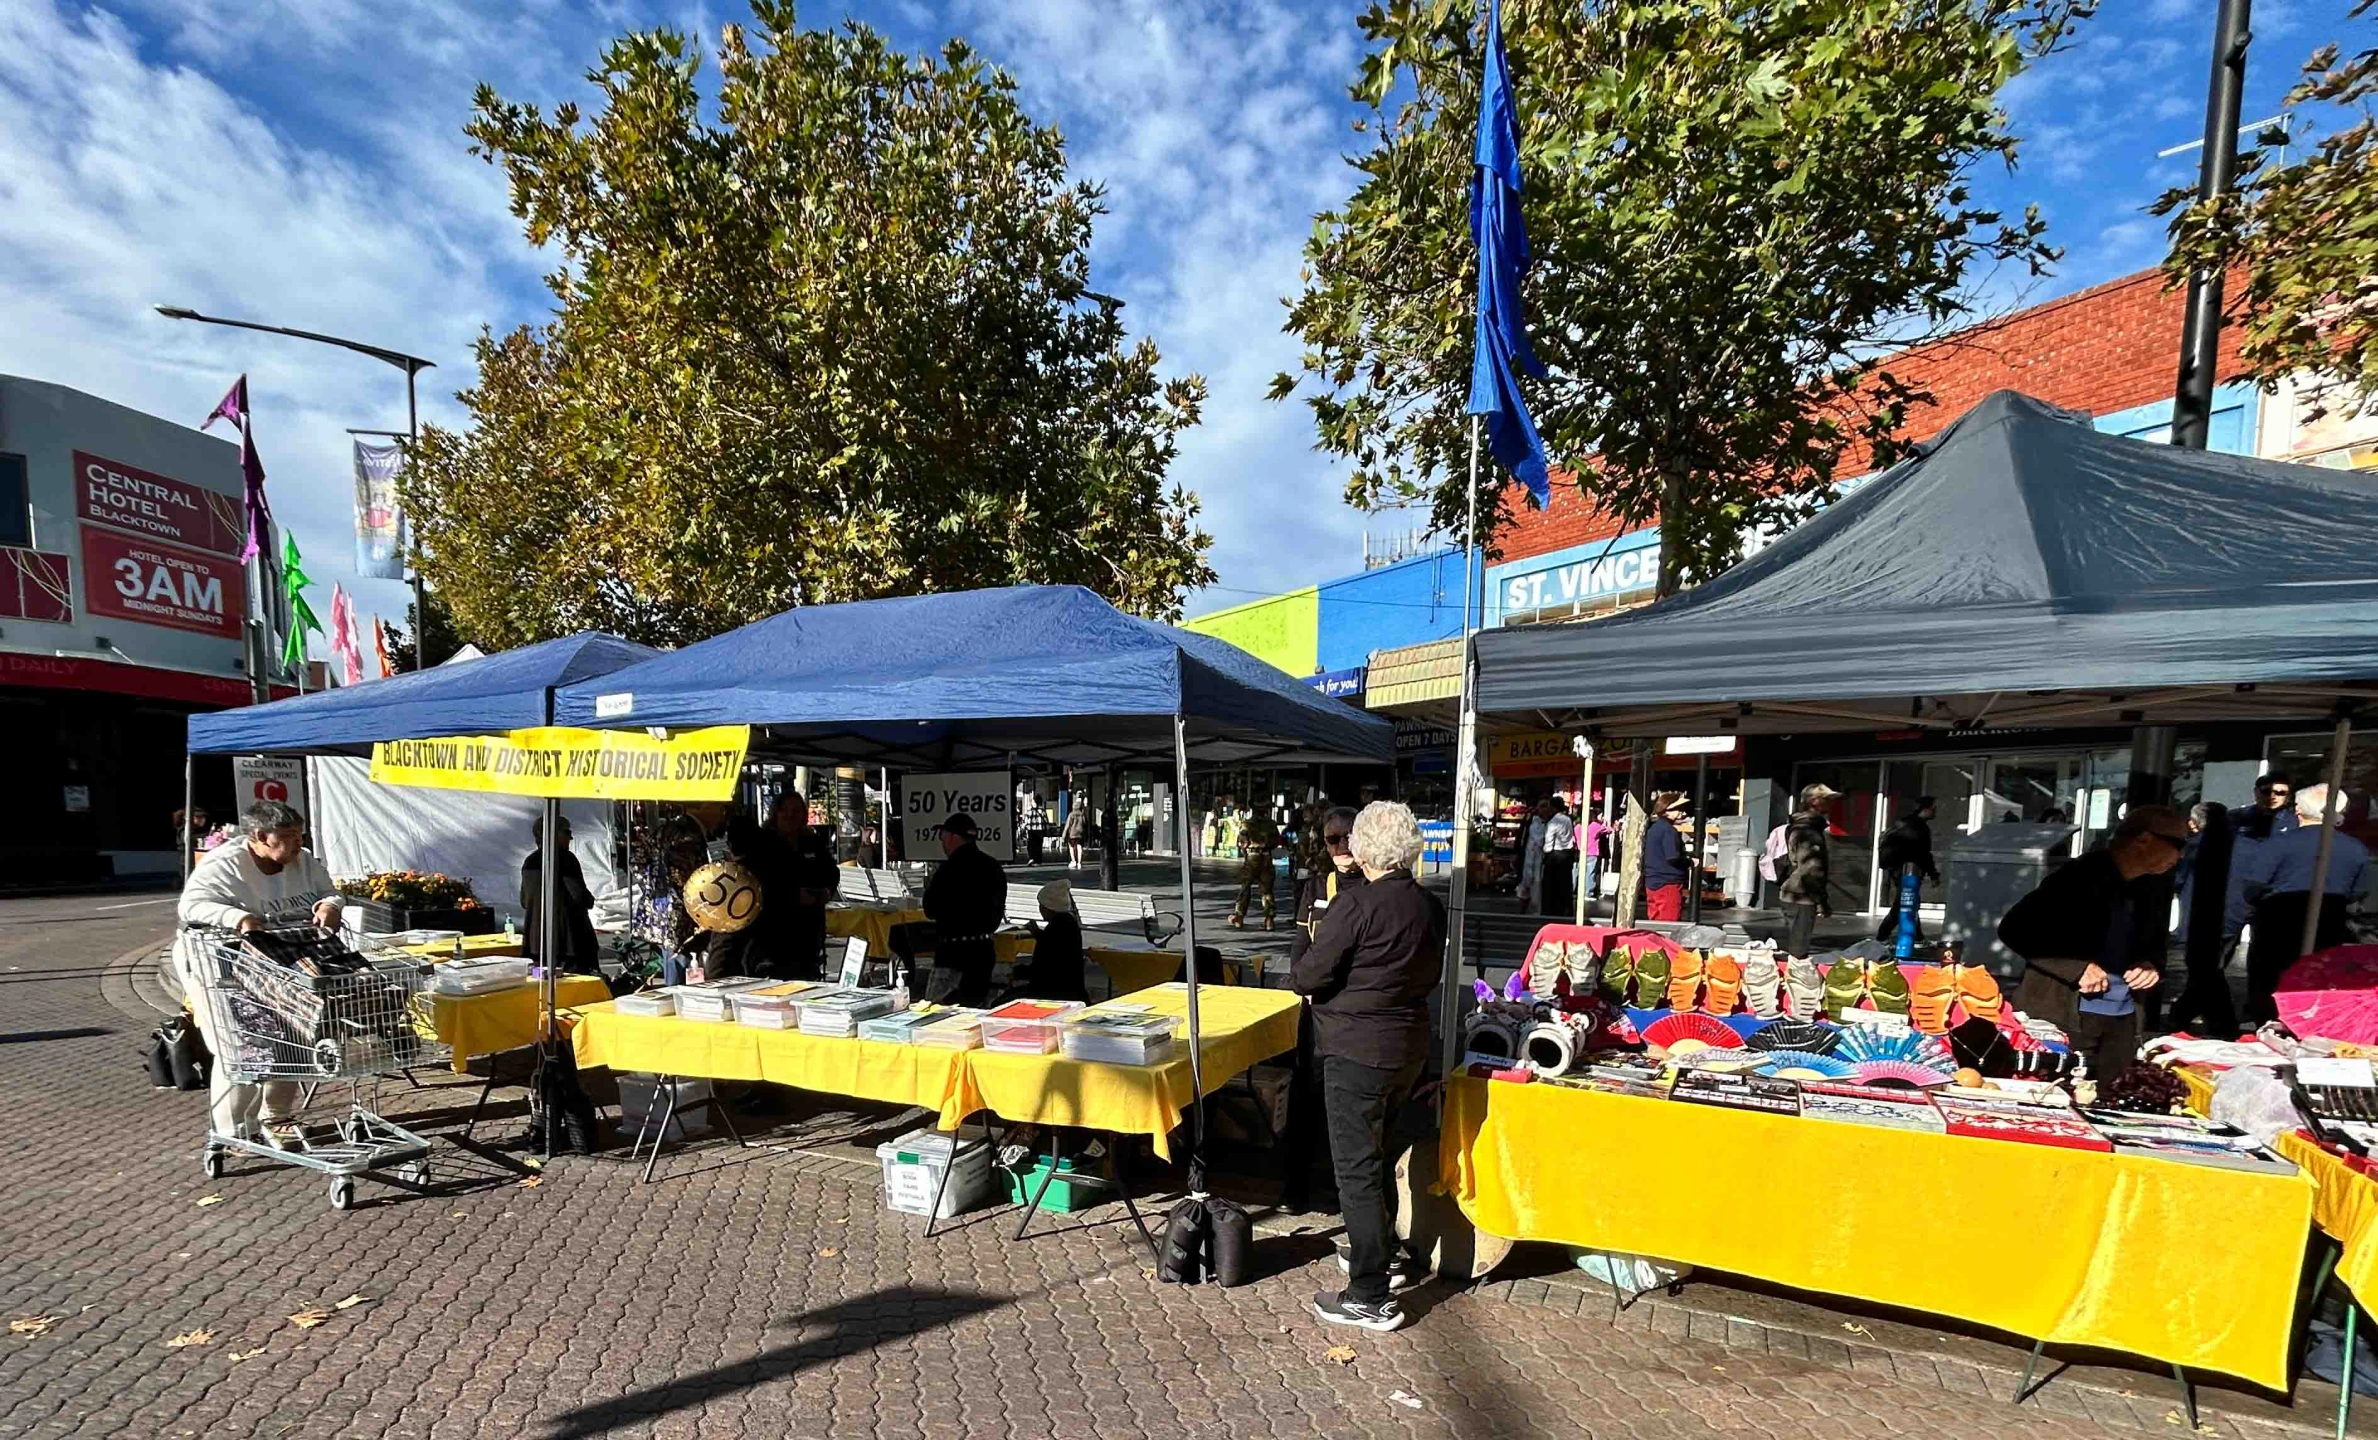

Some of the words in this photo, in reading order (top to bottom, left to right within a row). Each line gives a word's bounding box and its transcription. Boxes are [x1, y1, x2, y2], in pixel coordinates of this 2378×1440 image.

[86, 464, 199, 511] CENTRAL
[89, 483, 169, 520] HOTEL
[89, 504, 181, 537] BLACKTOWN
[129, 549, 164, 565] HOTEL
[166, 557, 194, 572] OPEN
[196, 564, 209, 575] TO
[114, 557, 224, 614] 3AM
[1508, 570, 1553, 609] ST.
[1558, 547, 1661, 599] VINCE
[123, 598, 174, 615] MIDNIGHT
[176, 608, 223, 625] SUNDAYS
[9, 656, 80, 676] DAILY
[1325, 678, 1339, 695] for
[1396, 733, 1421, 748] OPEN
[1423, 732, 1430, 746] 7
[1431, 731, 1457, 745] DAYS
[1510, 737, 1572, 758] BARGA
[241, 760, 294, 769] CLEARWAY
[383, 740, 457, 769] BLACKTOWN
[463, 745, 492, 771] AND
[494, 747, 562, 777] DISTRICT
[565, 748, 668, 780] HISTORICAL
[675, 750, 741, 780] SOCIETY
[262, 782, 280, 803] C
[908, 790, 936, 814] 50
[943, 790, 1008, 813] Years
[915, 827, 940, 842] 197
[976, 826, 1002, 842] 026
[699, 872, 756, 919] 50
